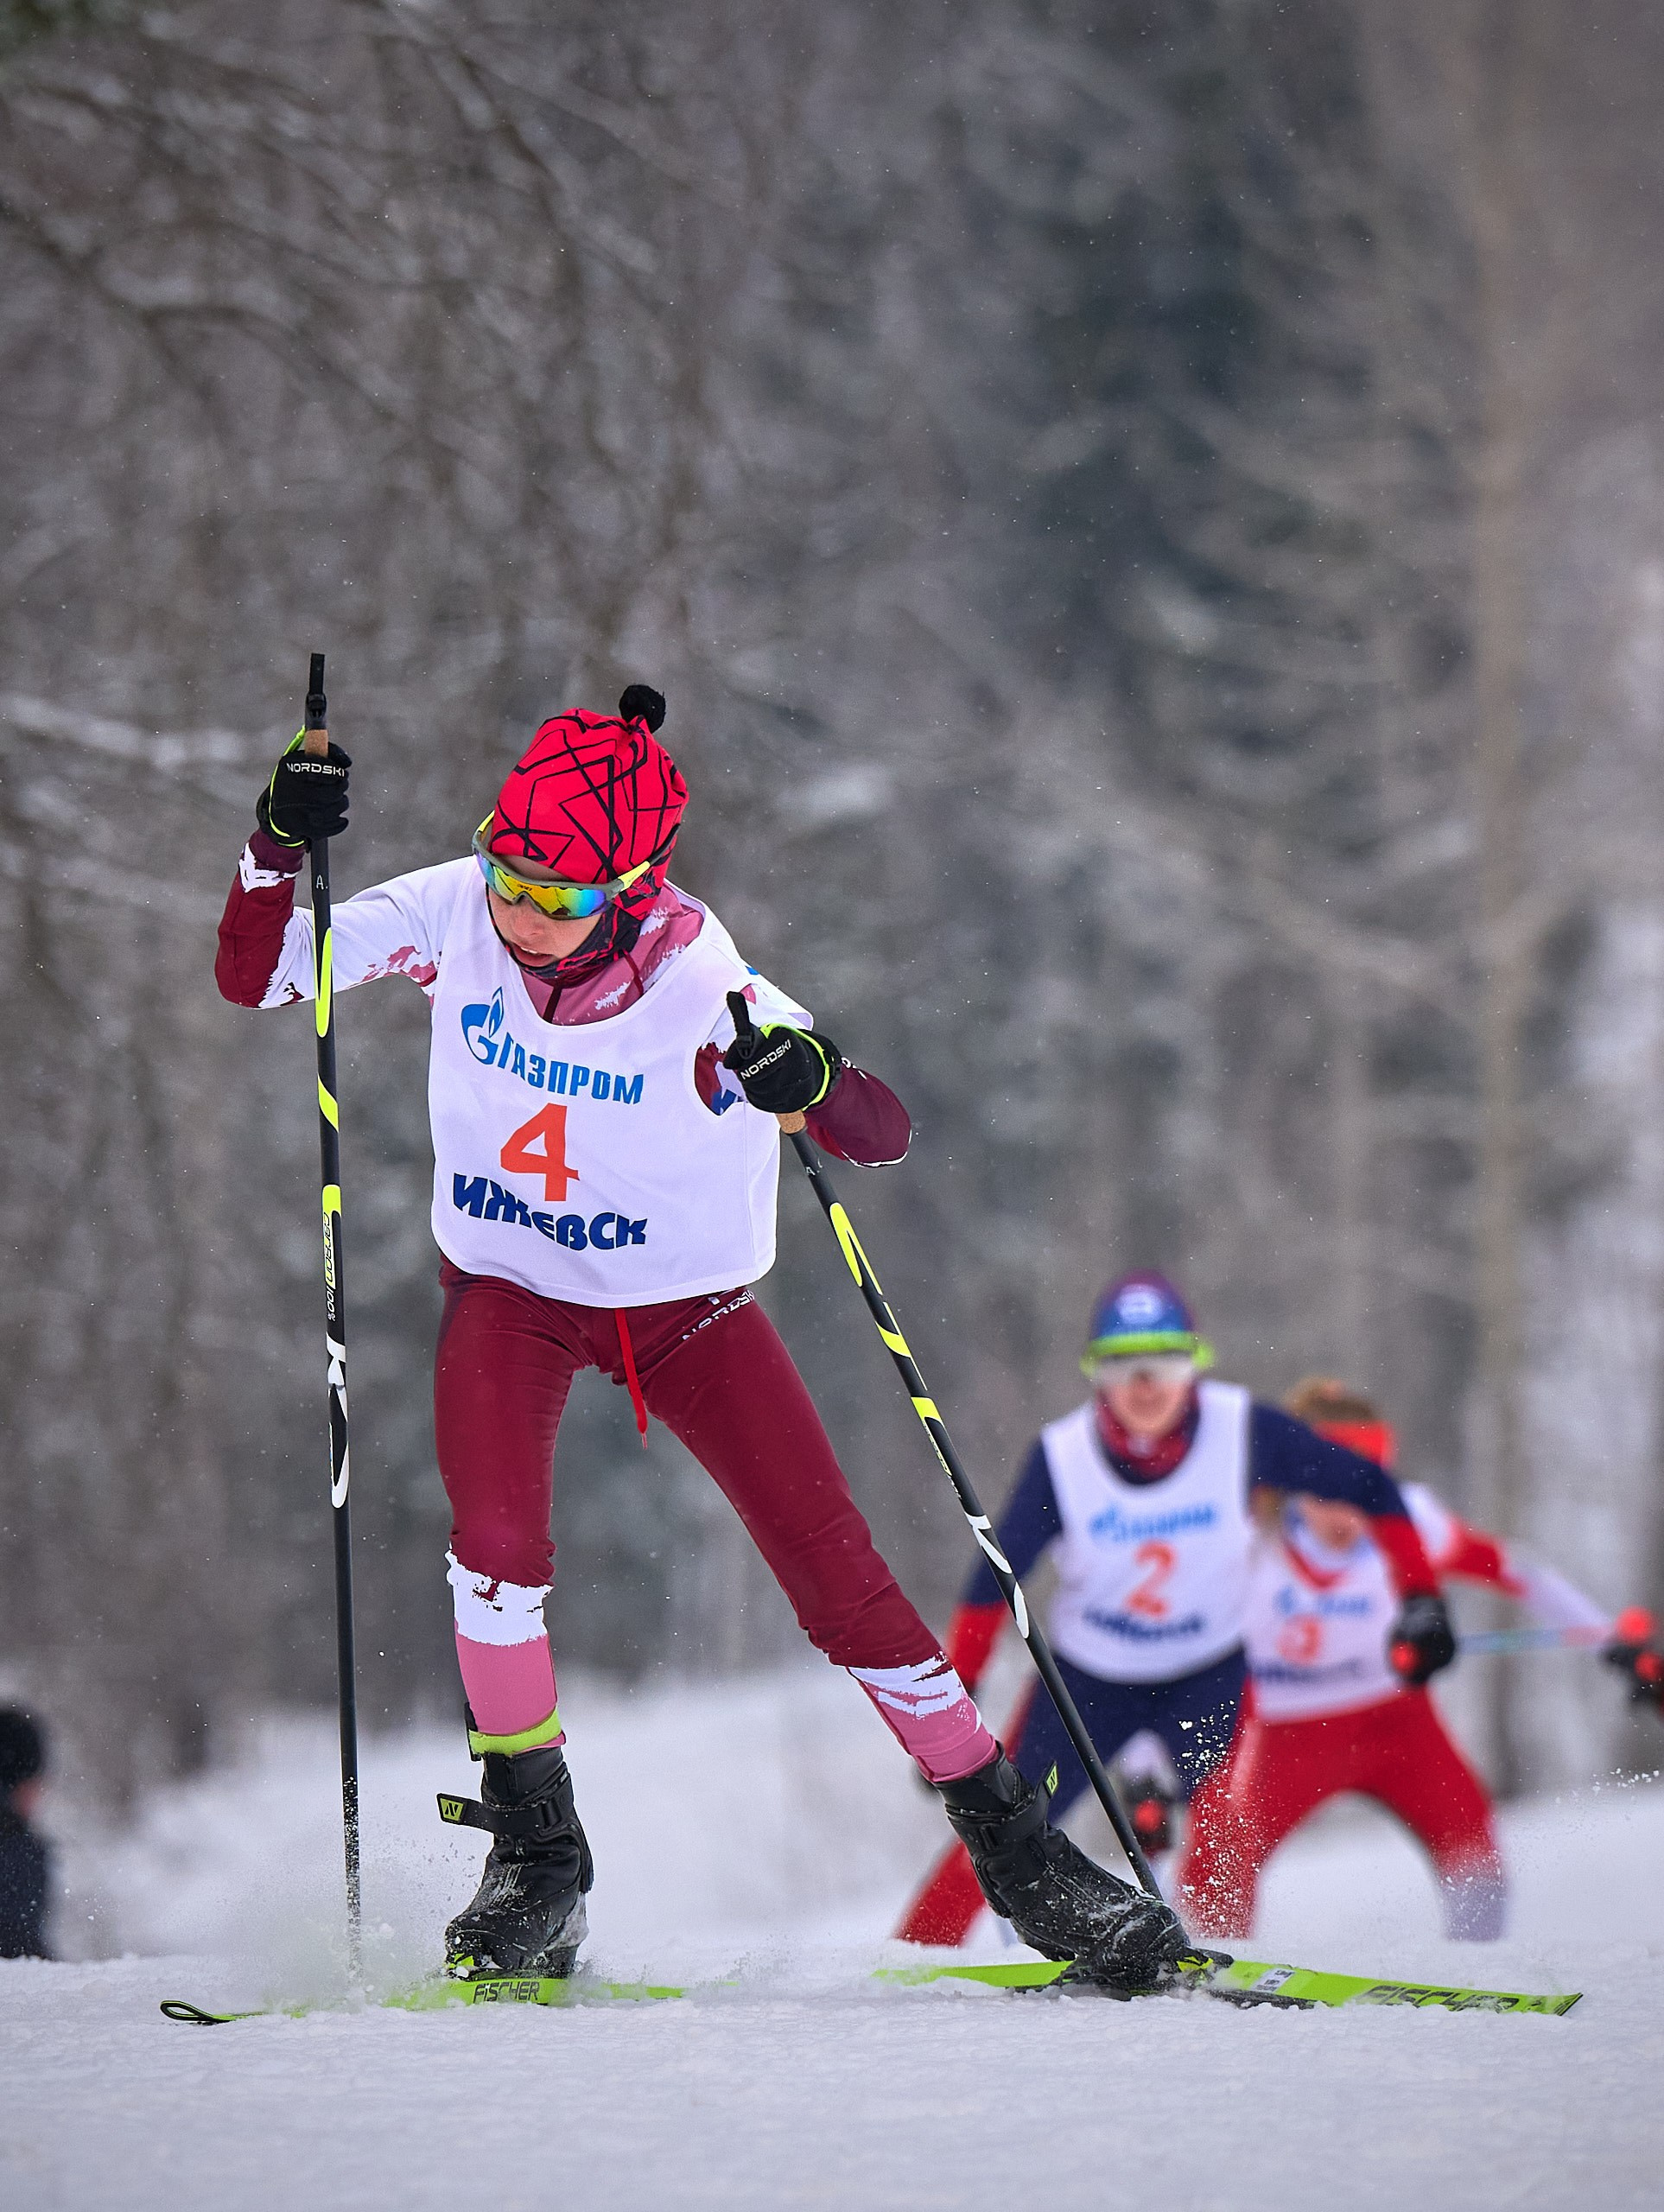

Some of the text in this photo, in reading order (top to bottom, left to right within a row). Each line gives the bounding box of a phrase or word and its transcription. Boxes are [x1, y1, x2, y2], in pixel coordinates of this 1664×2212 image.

[286, 762, 345, 777] NORDSKI
[498, 1032, 644, 1105] ГАЗПРОМ
[740, 1039, 791, 1080] NORDSKI
[500, 1103, 580, 1202] 4
[454, 1173, 648, 1251] ИЖЕВСК
[1126, 1540, 1178, 1621] 2
